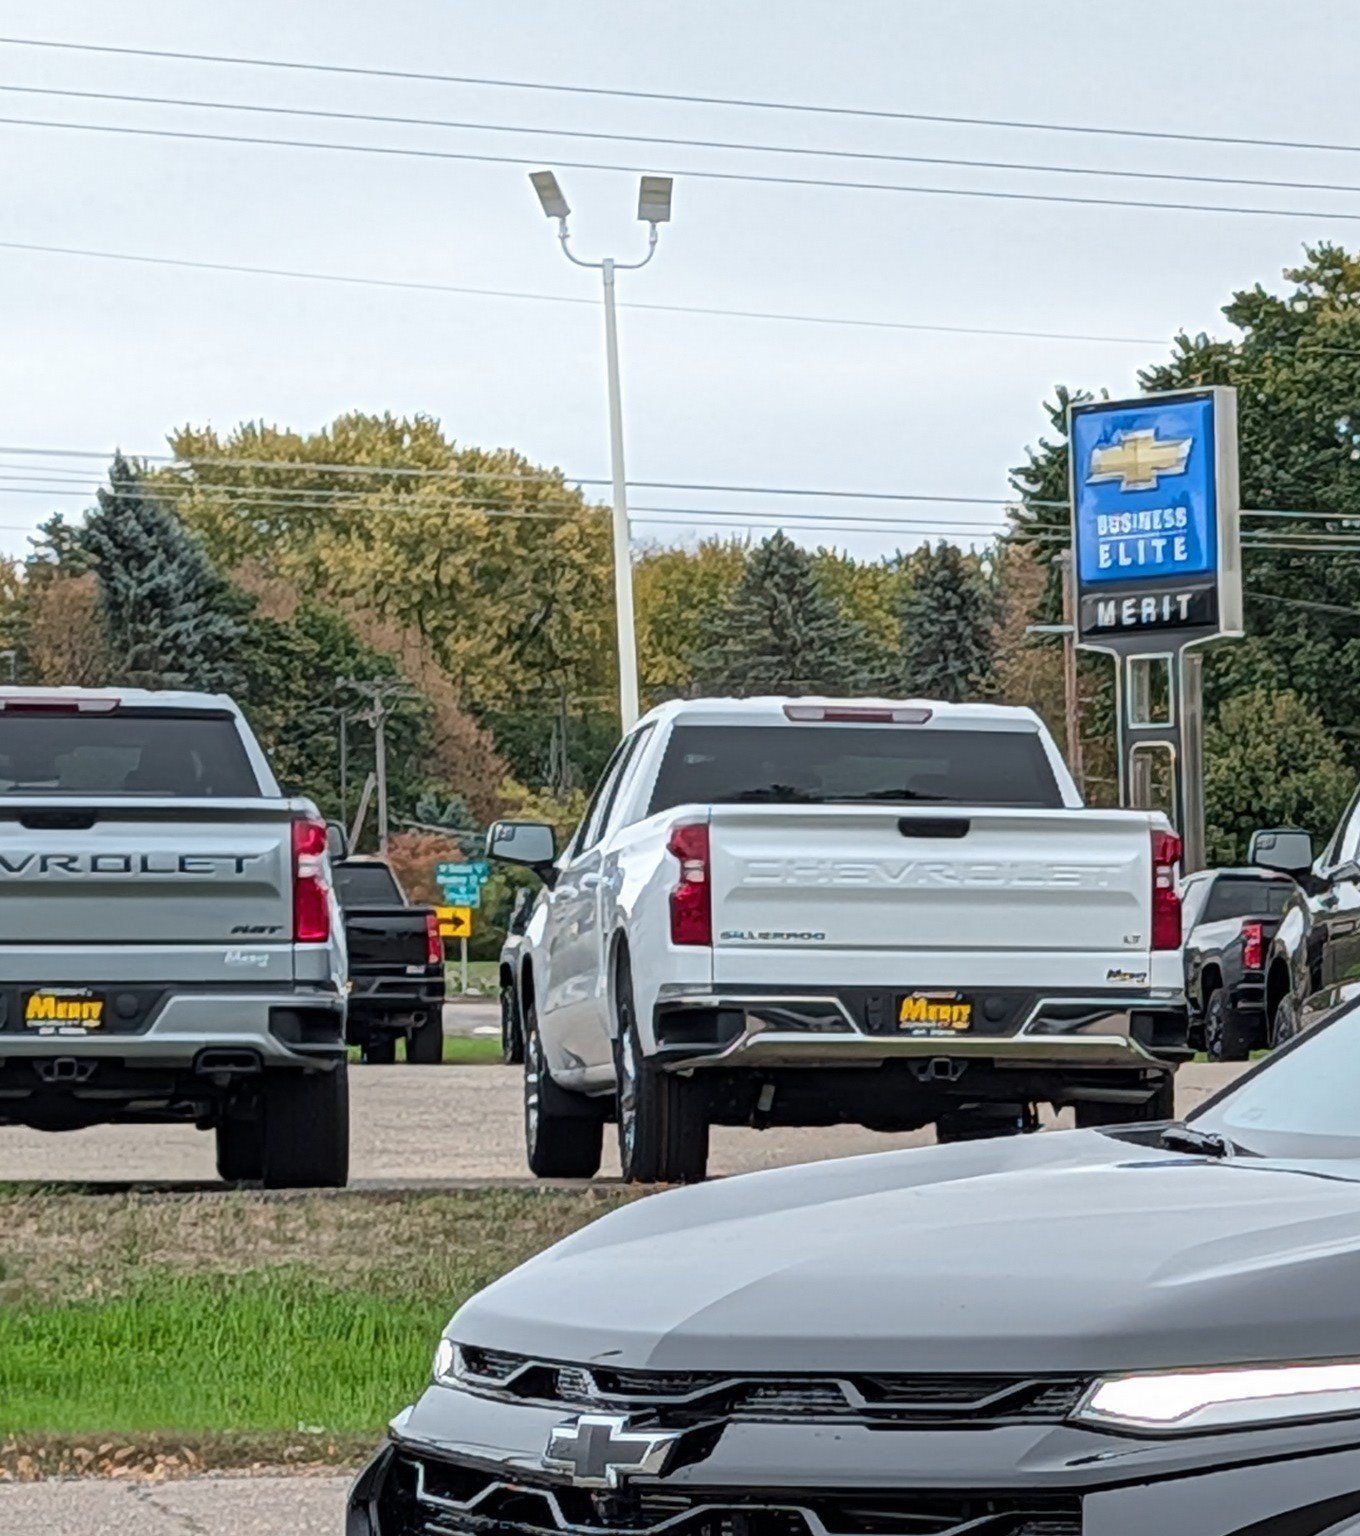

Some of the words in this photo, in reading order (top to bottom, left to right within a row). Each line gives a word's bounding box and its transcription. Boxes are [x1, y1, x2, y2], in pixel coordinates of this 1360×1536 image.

[1097, 507, 1187, 535] BUSINESS
[1098, 536, 1188, 569] ELITE
[1097, 593, 1193, 627] MERIT
[743, 859, 1122, 887] CHEVROLET
